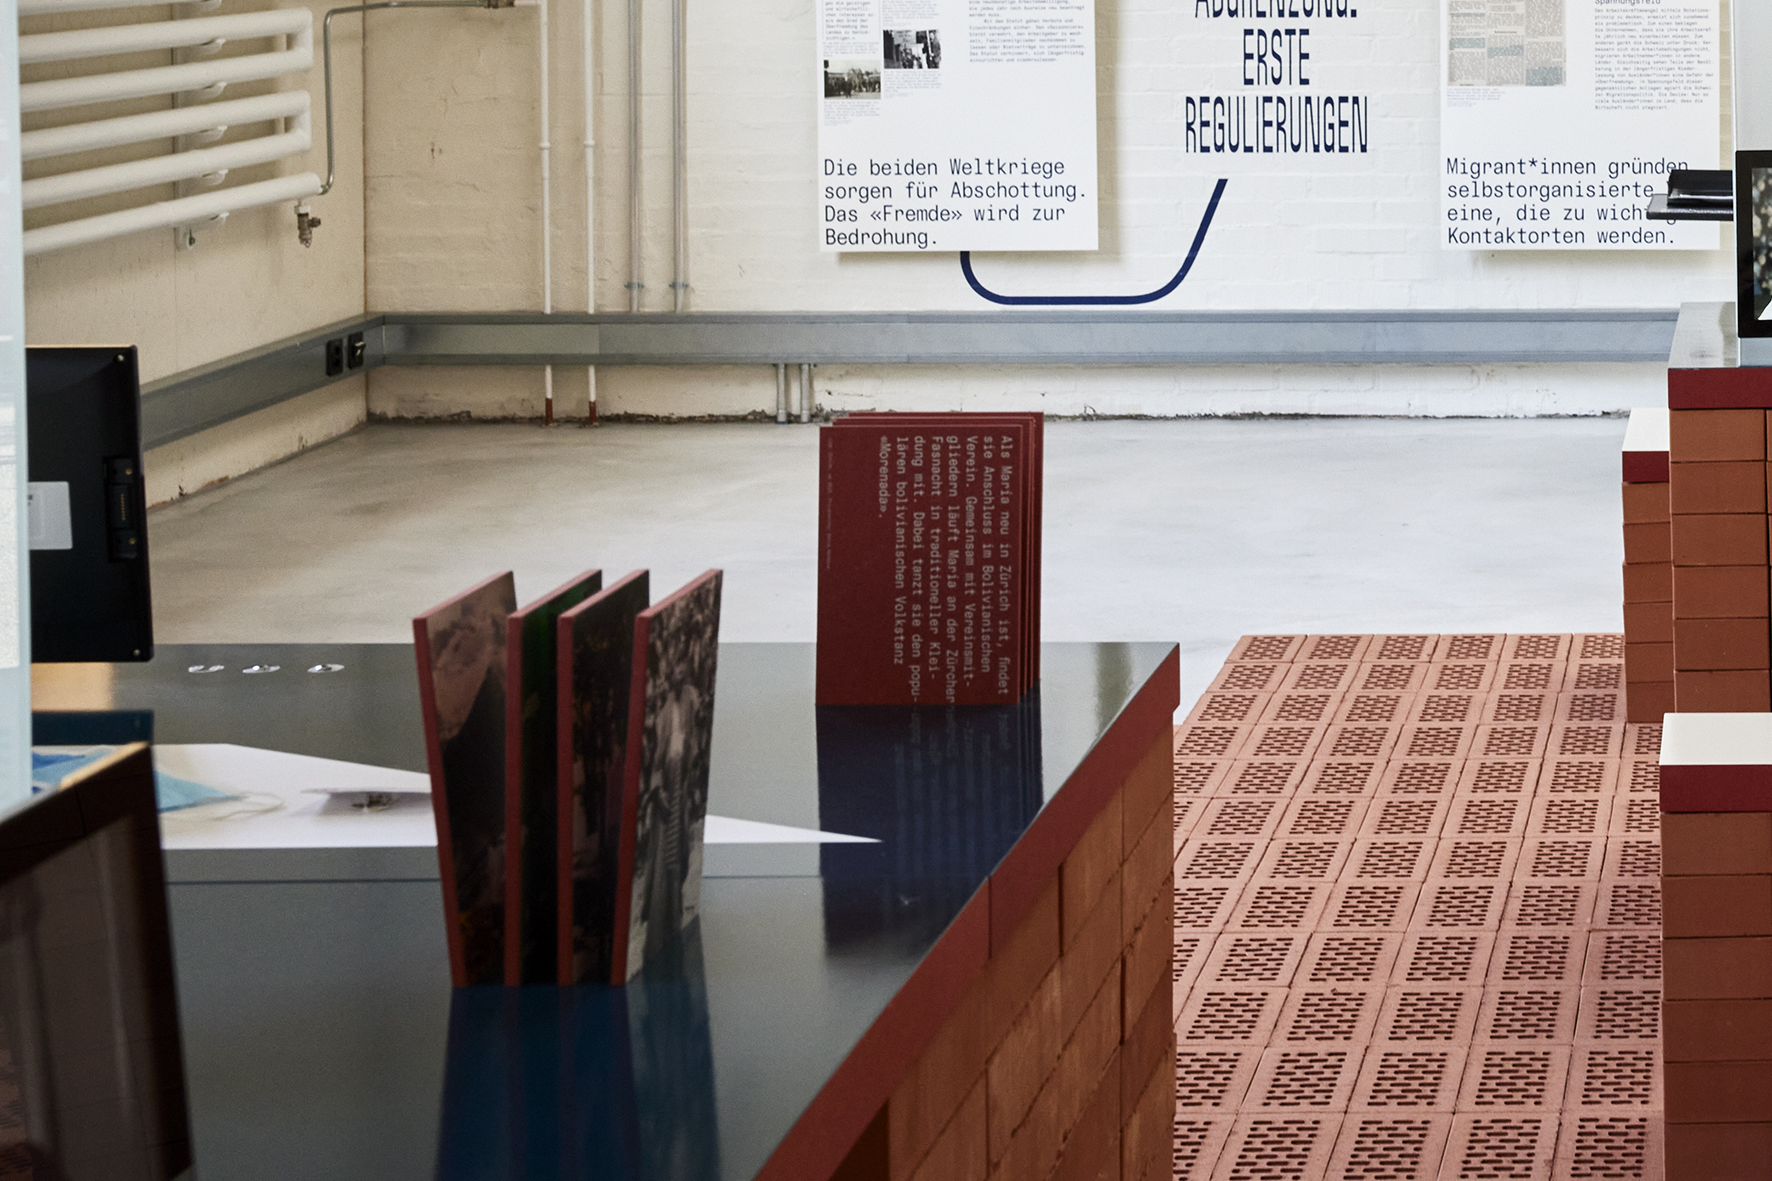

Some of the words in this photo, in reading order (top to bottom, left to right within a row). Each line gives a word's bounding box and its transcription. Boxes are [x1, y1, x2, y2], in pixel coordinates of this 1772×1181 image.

[1243, 28, 1310, 86] ERSTE
[1185, 96, 1367, 153] REGULIERUNGEN
[824, 158, 857, 176] Die
[870, 158, 938, 176] beiden
[949, 158, 1065, 179] Weltkriege
[1608, 157, 1689, 179] gründen
[825, 186, 892, 204] sorgen
[906, 181, 938, 199] für
[950, 181, 1085, 202] Abschottung.
[1448, 180, 1655, 203] selbstorganisierte
[825, 205, 858, 223] Das
[870, 204, 962, 222] «Fremde»
[974, 204, 1019, 221] wird
[1033, 208, 1065, 221] zur
[1447, 204, 1501, 225] eine,
[1516, 204, 1550, 221] die
[1563, 208, 1585, 221] zu
[825, 228, 936, 249] Bedrohung.
[1448, 227, 1585, 244] Kontaktorten
[1597, 227, 1674, 244] werden.
[983, 436, 995, 459] sie
[982, 466, 994, 535] Anschluss
[982, 543, 994, 558] im
[981, 565, 994, 672] Bolivianischen
